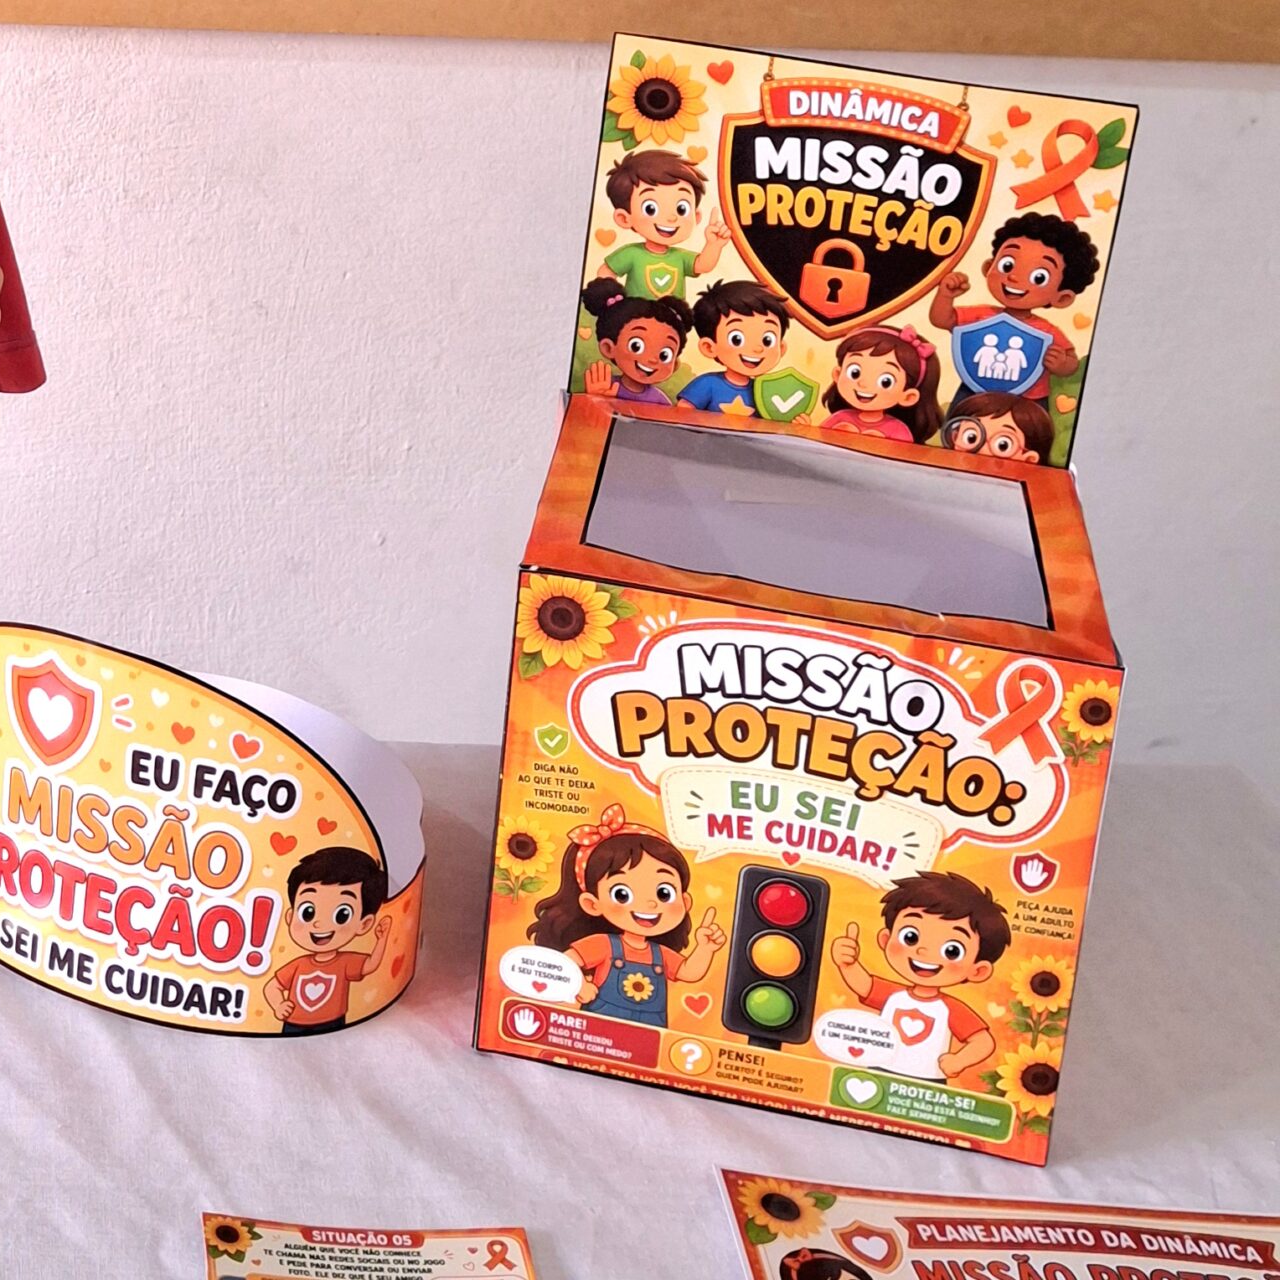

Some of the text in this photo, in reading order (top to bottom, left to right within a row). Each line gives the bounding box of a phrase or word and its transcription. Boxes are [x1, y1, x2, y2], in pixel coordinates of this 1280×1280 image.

[788, 89, 941, 138] DINÂMICA
[755, 135, 963, 208] MISSÃO
[737, 184, 964, 256] PROTEÇÃO
[679, 642, 944, 732] MISSÃO
[611, 691, 1028, 827] PROTEÇÃO:
[534, 763, 579, 775] DIGA NÃO
[131, 750, 298, 817] EU FAÇO
[518, 774, 595, 790] AO QUE TE DEIXA
[534, 788, 580, 801] TRISTE OU
[525, 800, 590, 814] INCOMODADO!
[730, 780, 863, 832] EU SEI
[8, 767, 243, 890] MISSÃO
[707, 814, 898, 872] ME CUIDAR!
[1017, 900, 1073, 916] PEÇA AJUDA
[1011, 924, 1021, 932] DE
[1023, 914, 1037, 922] UM
[1040, 917, 1074, 929] ADULTO
[0, 919, 38, 963] SEI
[48, 942, 93, 986] ME
[105, 964, 245, 1018] CUIDAR!
[521, 957, 563, 972] SEU CORPO
[518, 966, 532, 976] SEU
[534, 970, 571, 984] TESOURO!
[549, 1012, 587, 1030] PARE!
[548, 1034, 572, 1047] TRISTE
[574, 1040, 585, 1050] OU
[587, 1043, 604, 1054] COM
[718, 1048, 765, 1067] PENSE!
[716, 1072, 739, 1082] QUEM
[742, 1076, 763, 1087] PODE
[889, 1083, 976, 1111] PROTEJA-SE!
[312, 1229, 412, 1247] SITUAÇÃO 05
[918, 1224, 1264, 1264] PLANEJAMENTO DA DINÂMICA
[276, 1250, 306, 1259] CHAMA
[309, 1253, 326, 1262] NAS
[329, 1255, 355, 1263] REDES
[393, 1258, 405, 1266] OU
[319, 1246, 335, 1254] QUE
[363, 1248, 380, 1256] NÃO
